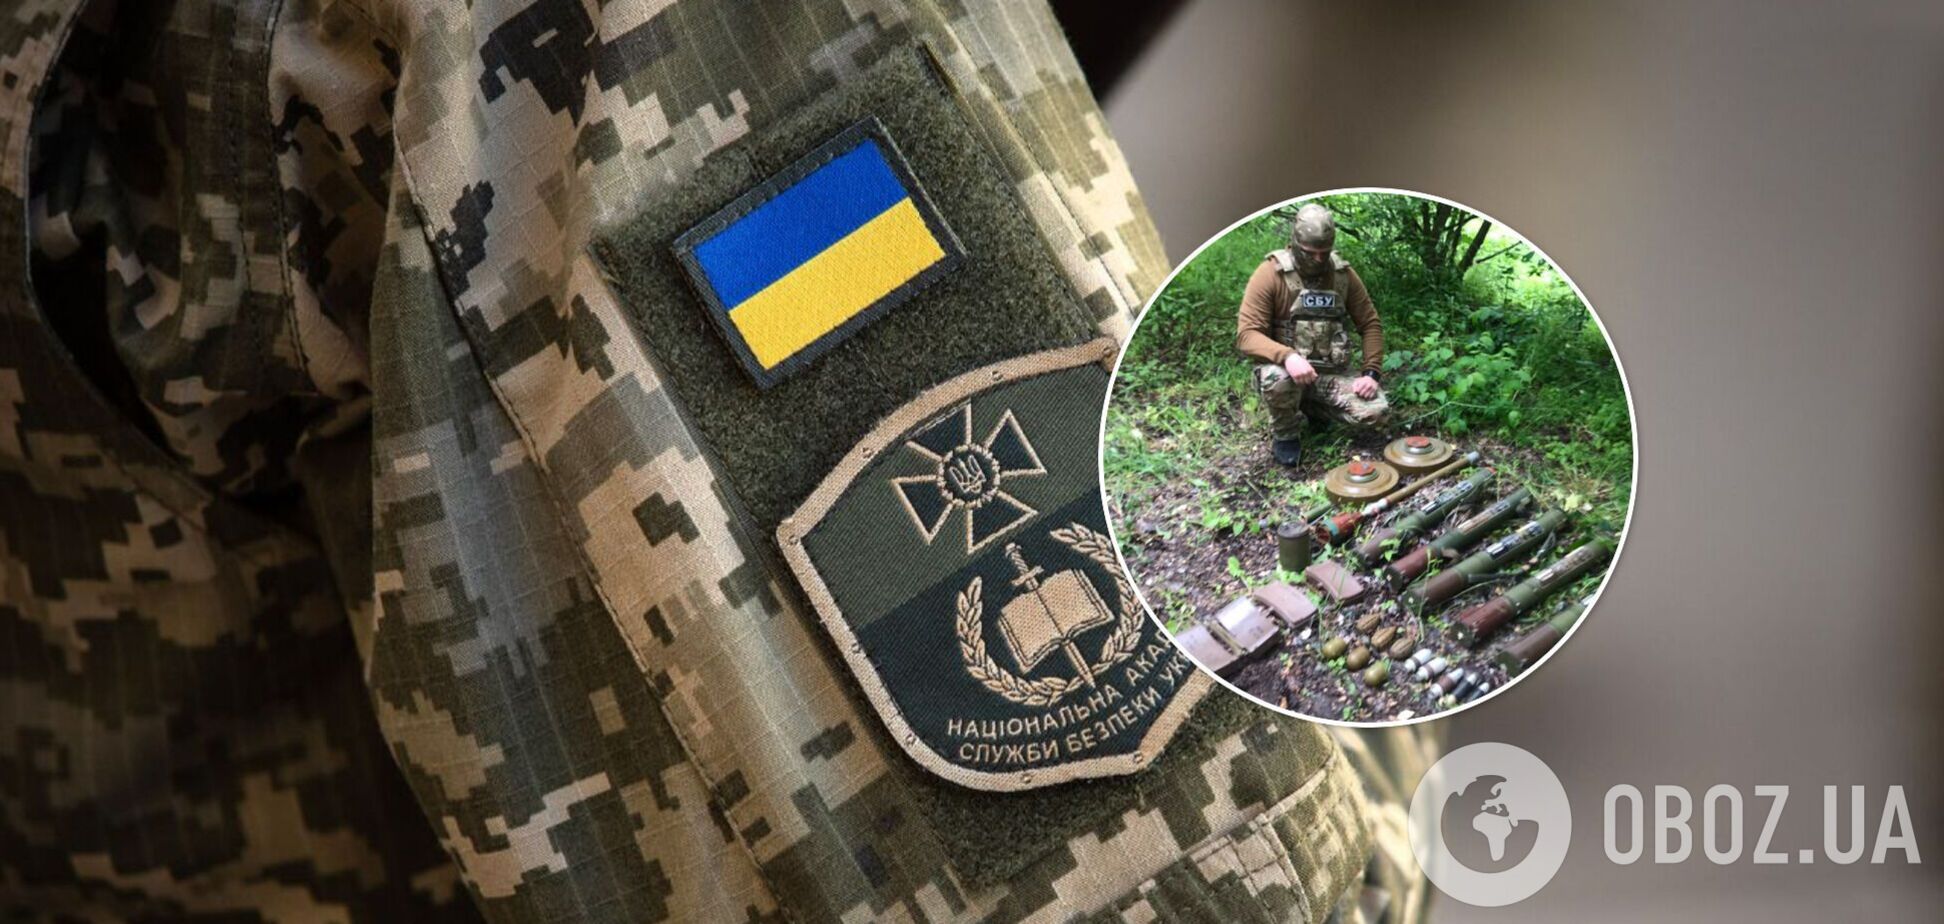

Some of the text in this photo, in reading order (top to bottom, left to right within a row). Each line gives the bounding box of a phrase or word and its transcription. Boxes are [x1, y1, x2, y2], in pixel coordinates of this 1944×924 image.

[1306, 295, 1332, 307] СБУ
[948, 684, 1123, 738] НАЦІОНАЛЬНА
[959, 740, 1059, 764] СЛУЖБИ
[1066, 686, 1162, 753] БЕЗПЕКИ
